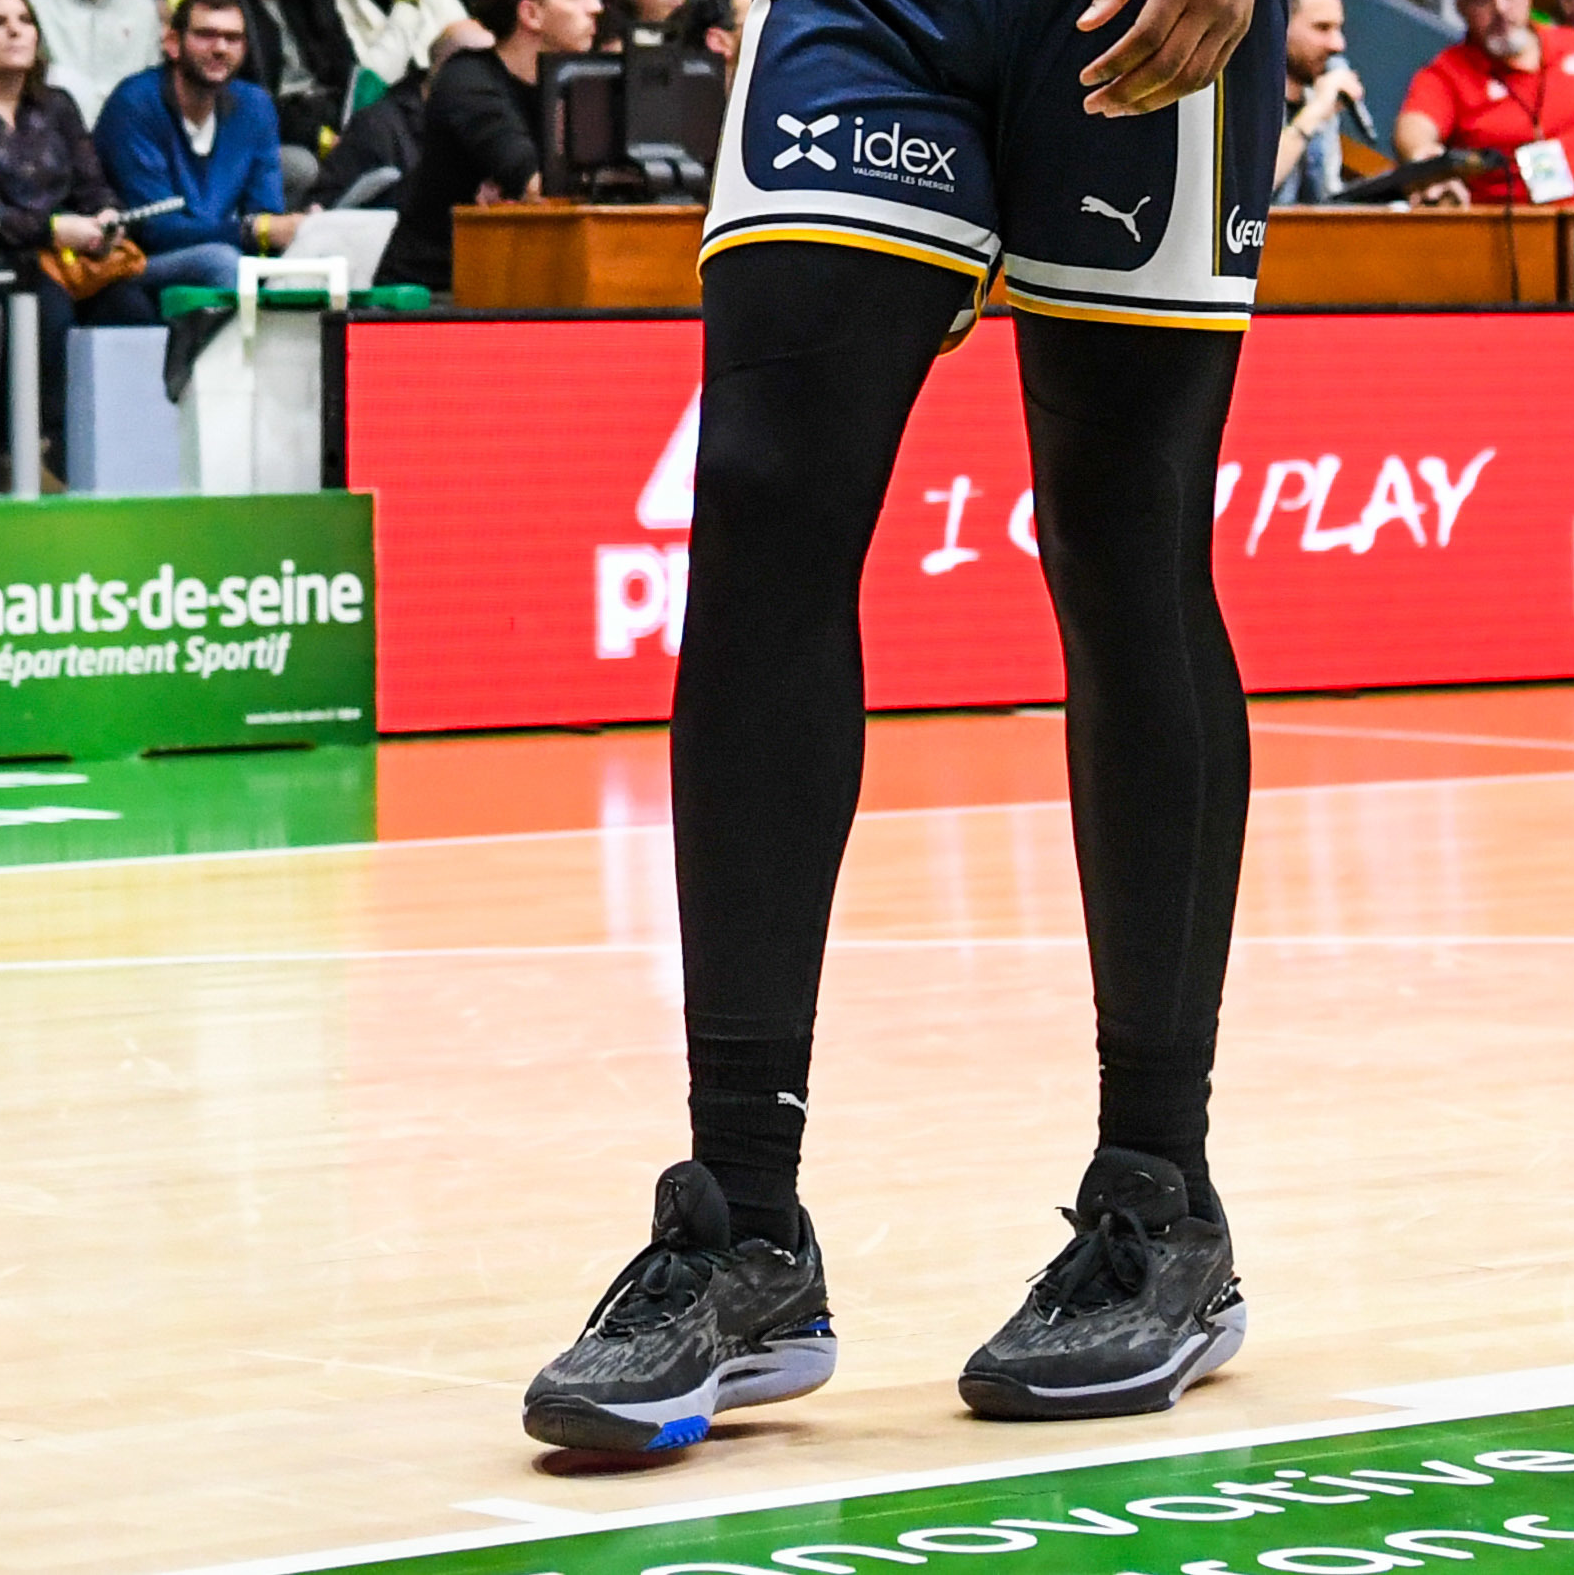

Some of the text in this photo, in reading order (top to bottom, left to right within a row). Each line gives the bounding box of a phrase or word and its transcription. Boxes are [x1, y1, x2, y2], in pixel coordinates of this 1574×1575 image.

[853, 116, 957, 181] idex
[901, 175, 915, 185] LES
[1243, 448, 1497, 558] PLAY
[183, 632, 294, 678] Sportif
